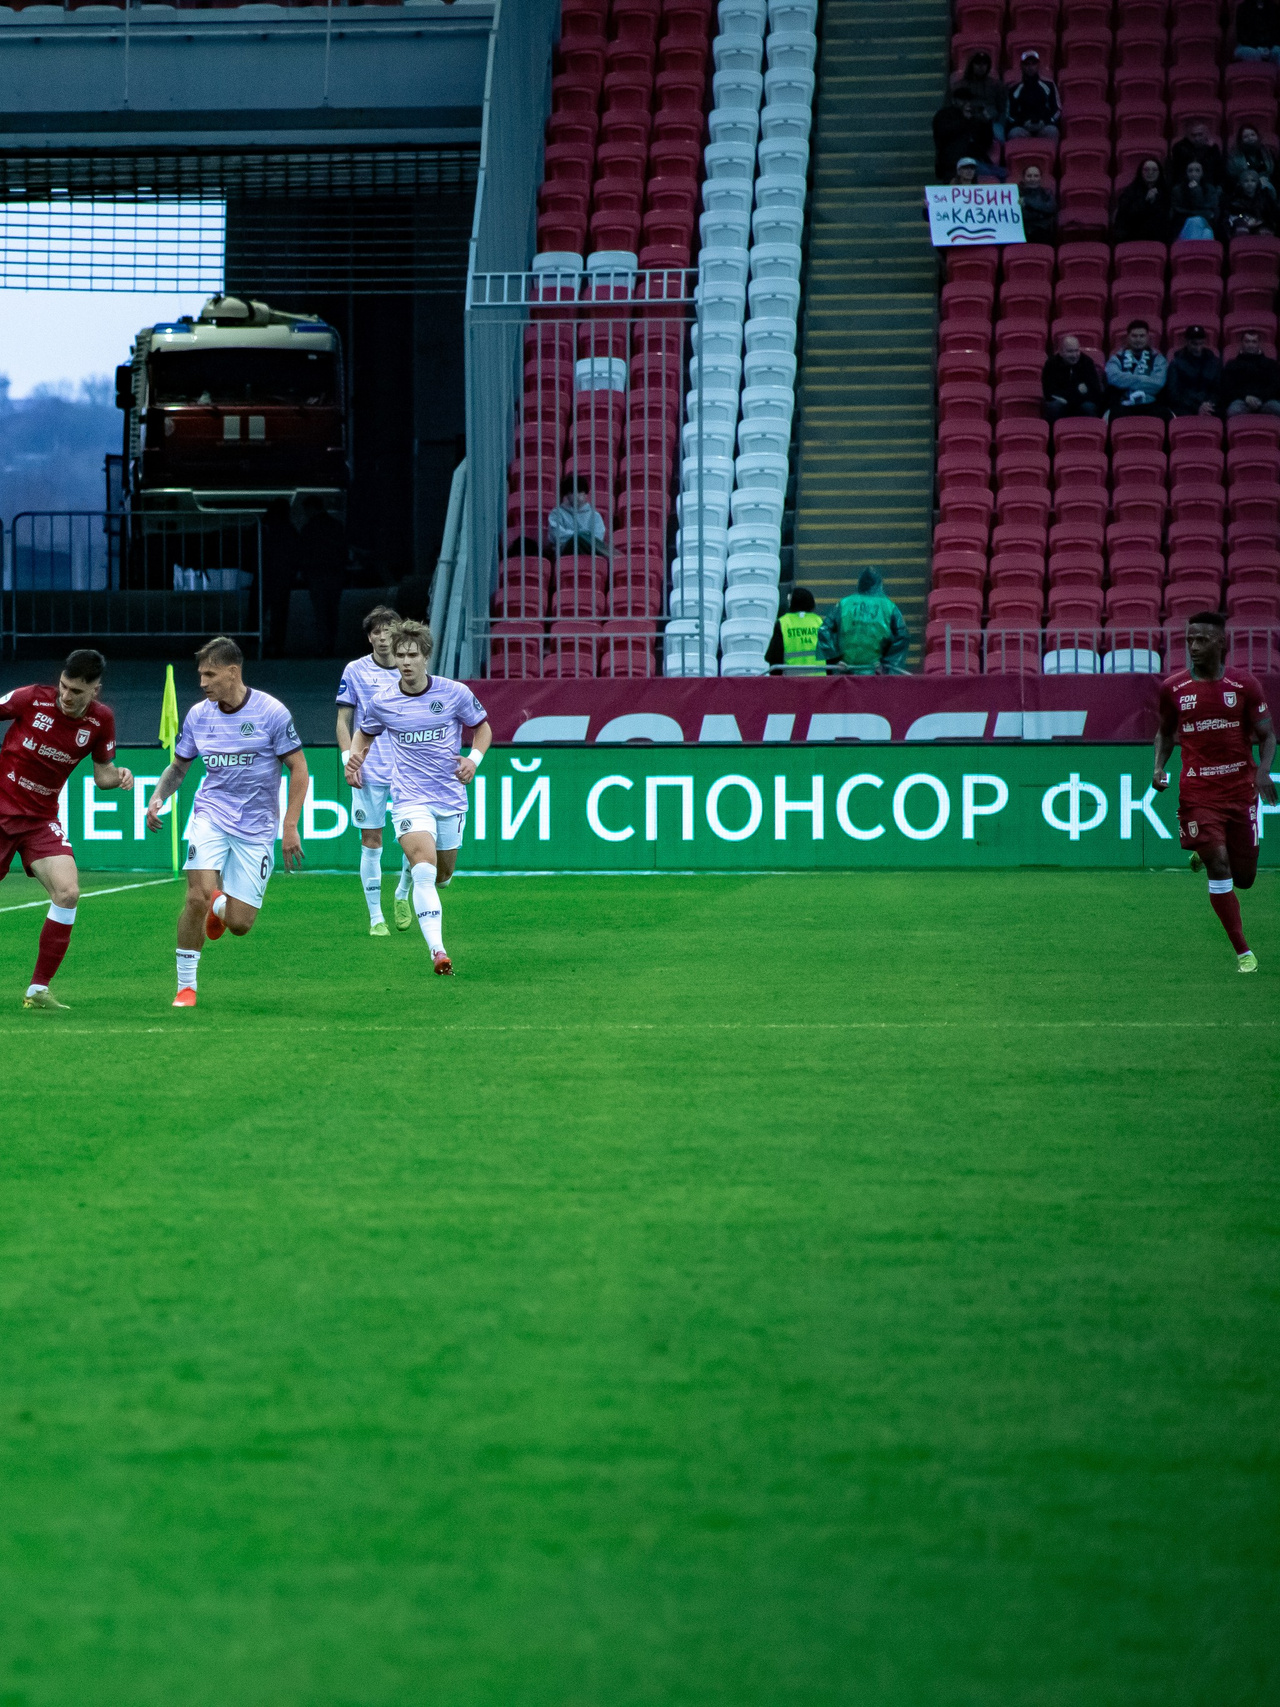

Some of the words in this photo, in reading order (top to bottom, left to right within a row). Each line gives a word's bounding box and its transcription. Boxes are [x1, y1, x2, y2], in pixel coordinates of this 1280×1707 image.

[951, 187, 1013, 206] РУБИН
[951, 207, 1021, 224] КАЗАНЬ
[787, 627, 818, 638] STEWAR
[1180, 694, 1197, 703] FON
[1181, 701, 1198, 711] BET
[32, 719, 53, 732] BET
[35, 711, 55, 725] FON
[397, 726, 449, 744] FONBET
[201, 752, 257, 769] FONBET
[586, 773, 1010, 842] СПОНСОР
[1041, 772, 1174, 841] ФК
[260, 855, 269, 880] 6
